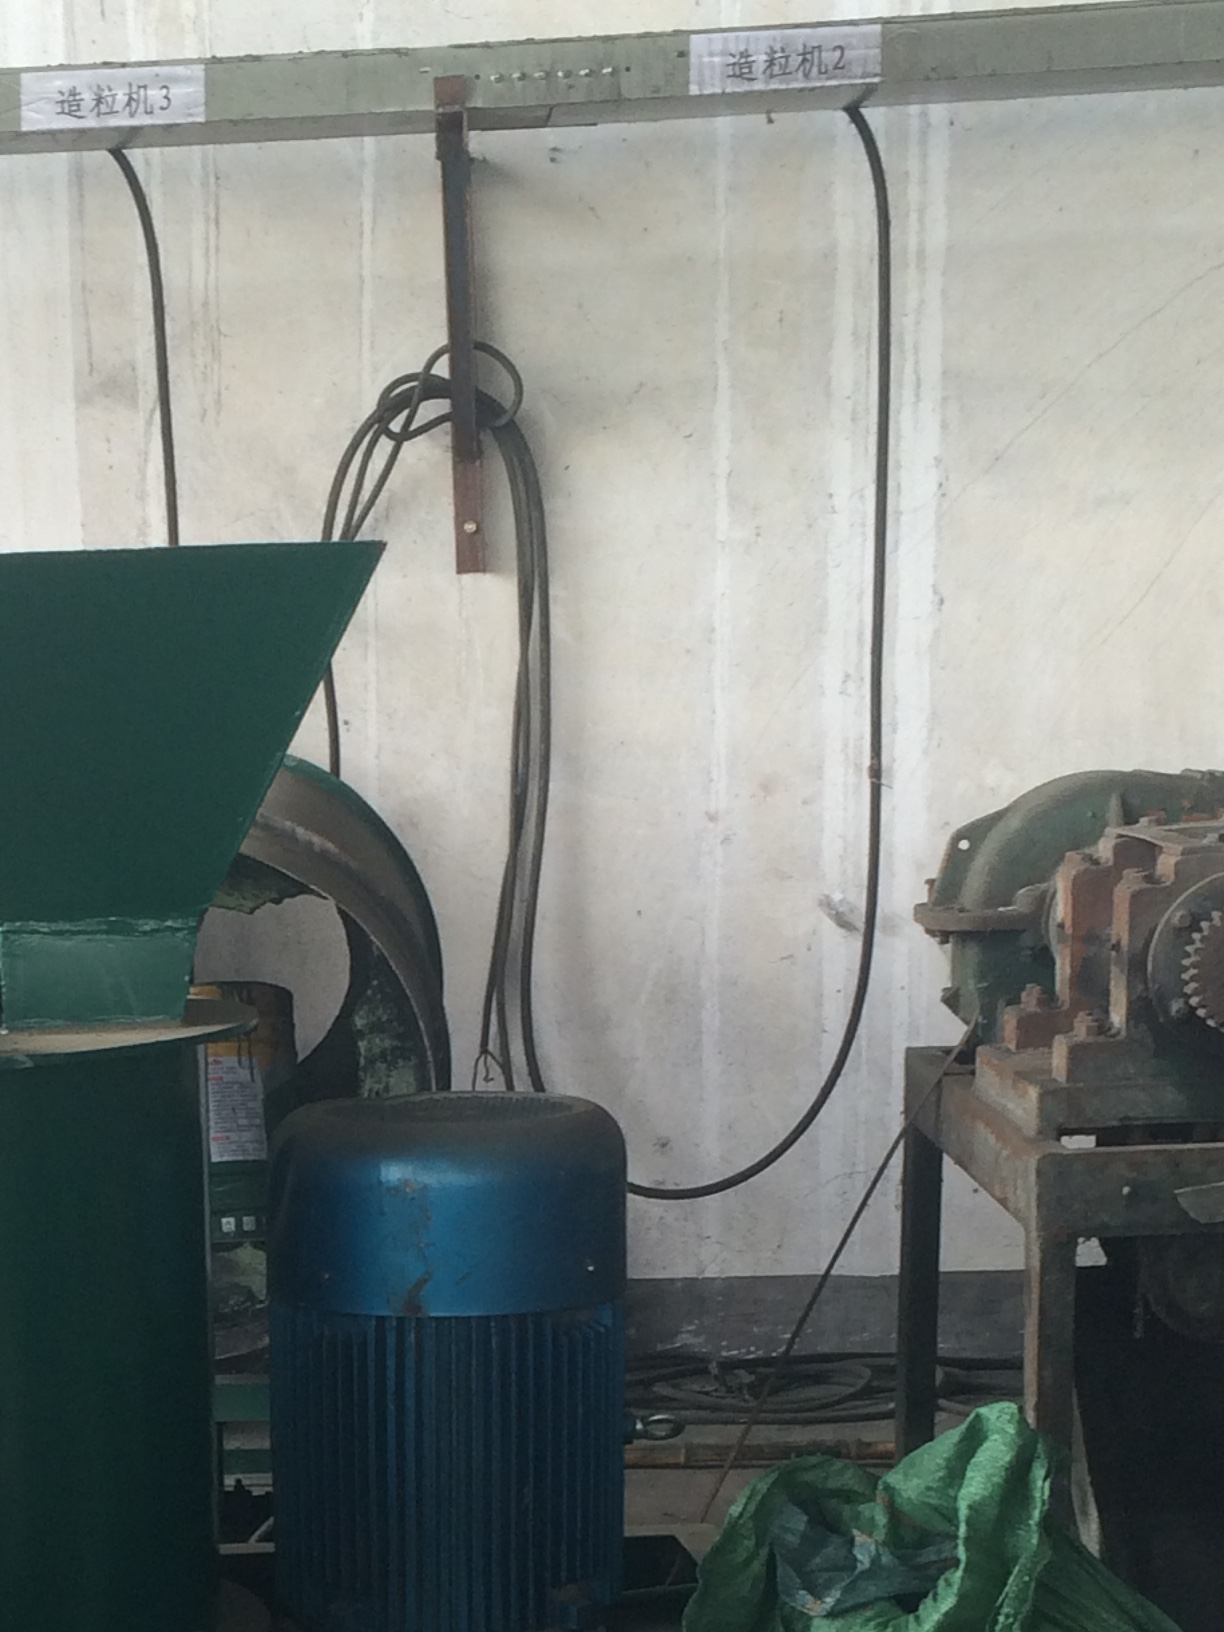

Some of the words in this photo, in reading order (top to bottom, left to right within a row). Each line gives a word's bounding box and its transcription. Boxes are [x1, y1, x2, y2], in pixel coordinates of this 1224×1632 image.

[726, 43, 846, 81] 造粒机2
[55, 82, 173, 119] 造粒机3
